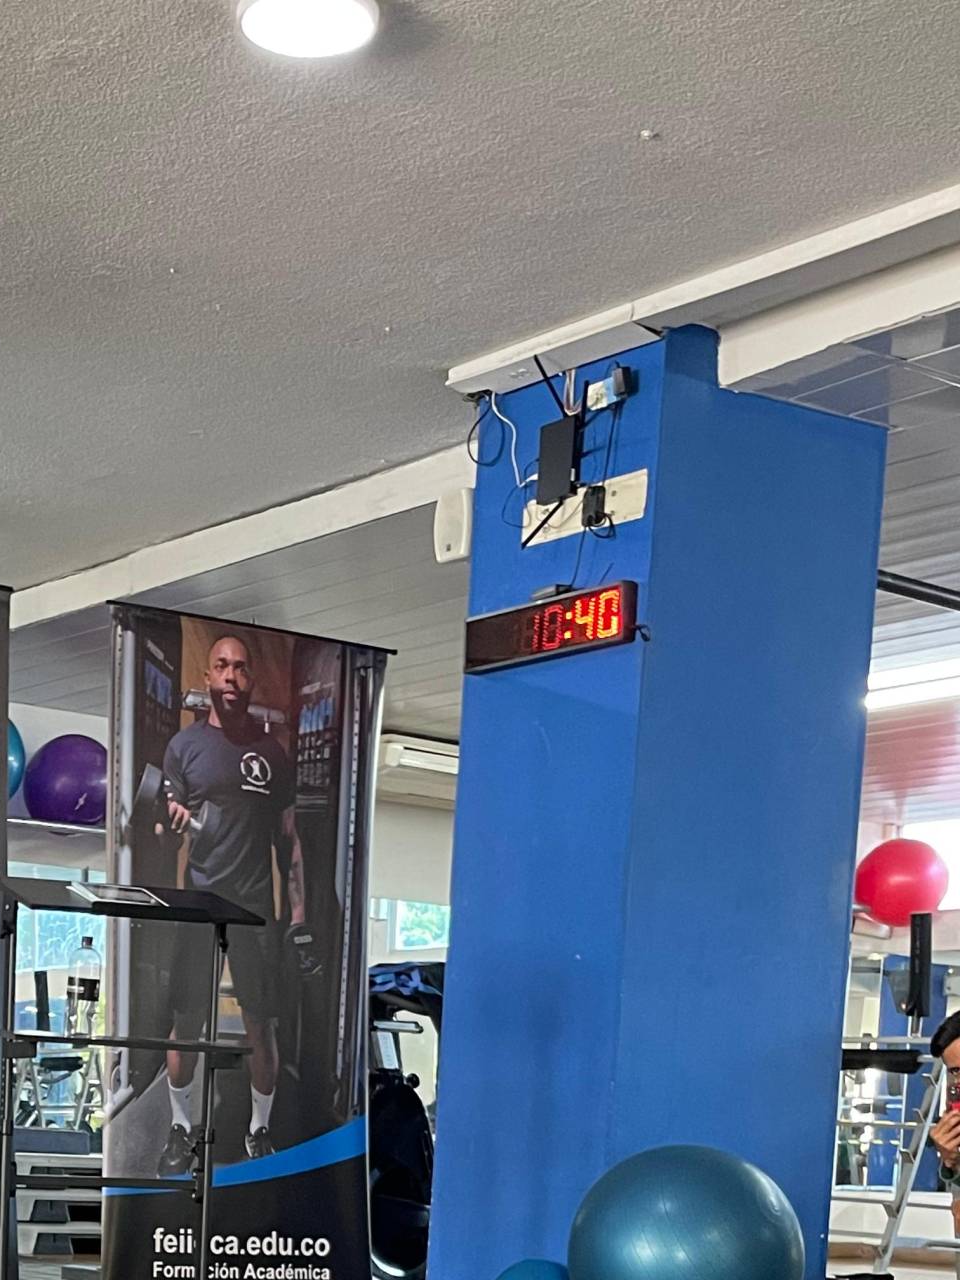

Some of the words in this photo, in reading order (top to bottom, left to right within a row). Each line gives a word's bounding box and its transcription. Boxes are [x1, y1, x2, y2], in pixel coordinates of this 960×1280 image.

[531, 589, 620, 651] 10:40
[153, 1227, 331, 1257] feiica.edu.co
[152, 1261, 239, 1279] Formción
[243, 1262, 331, 1280] Académica
